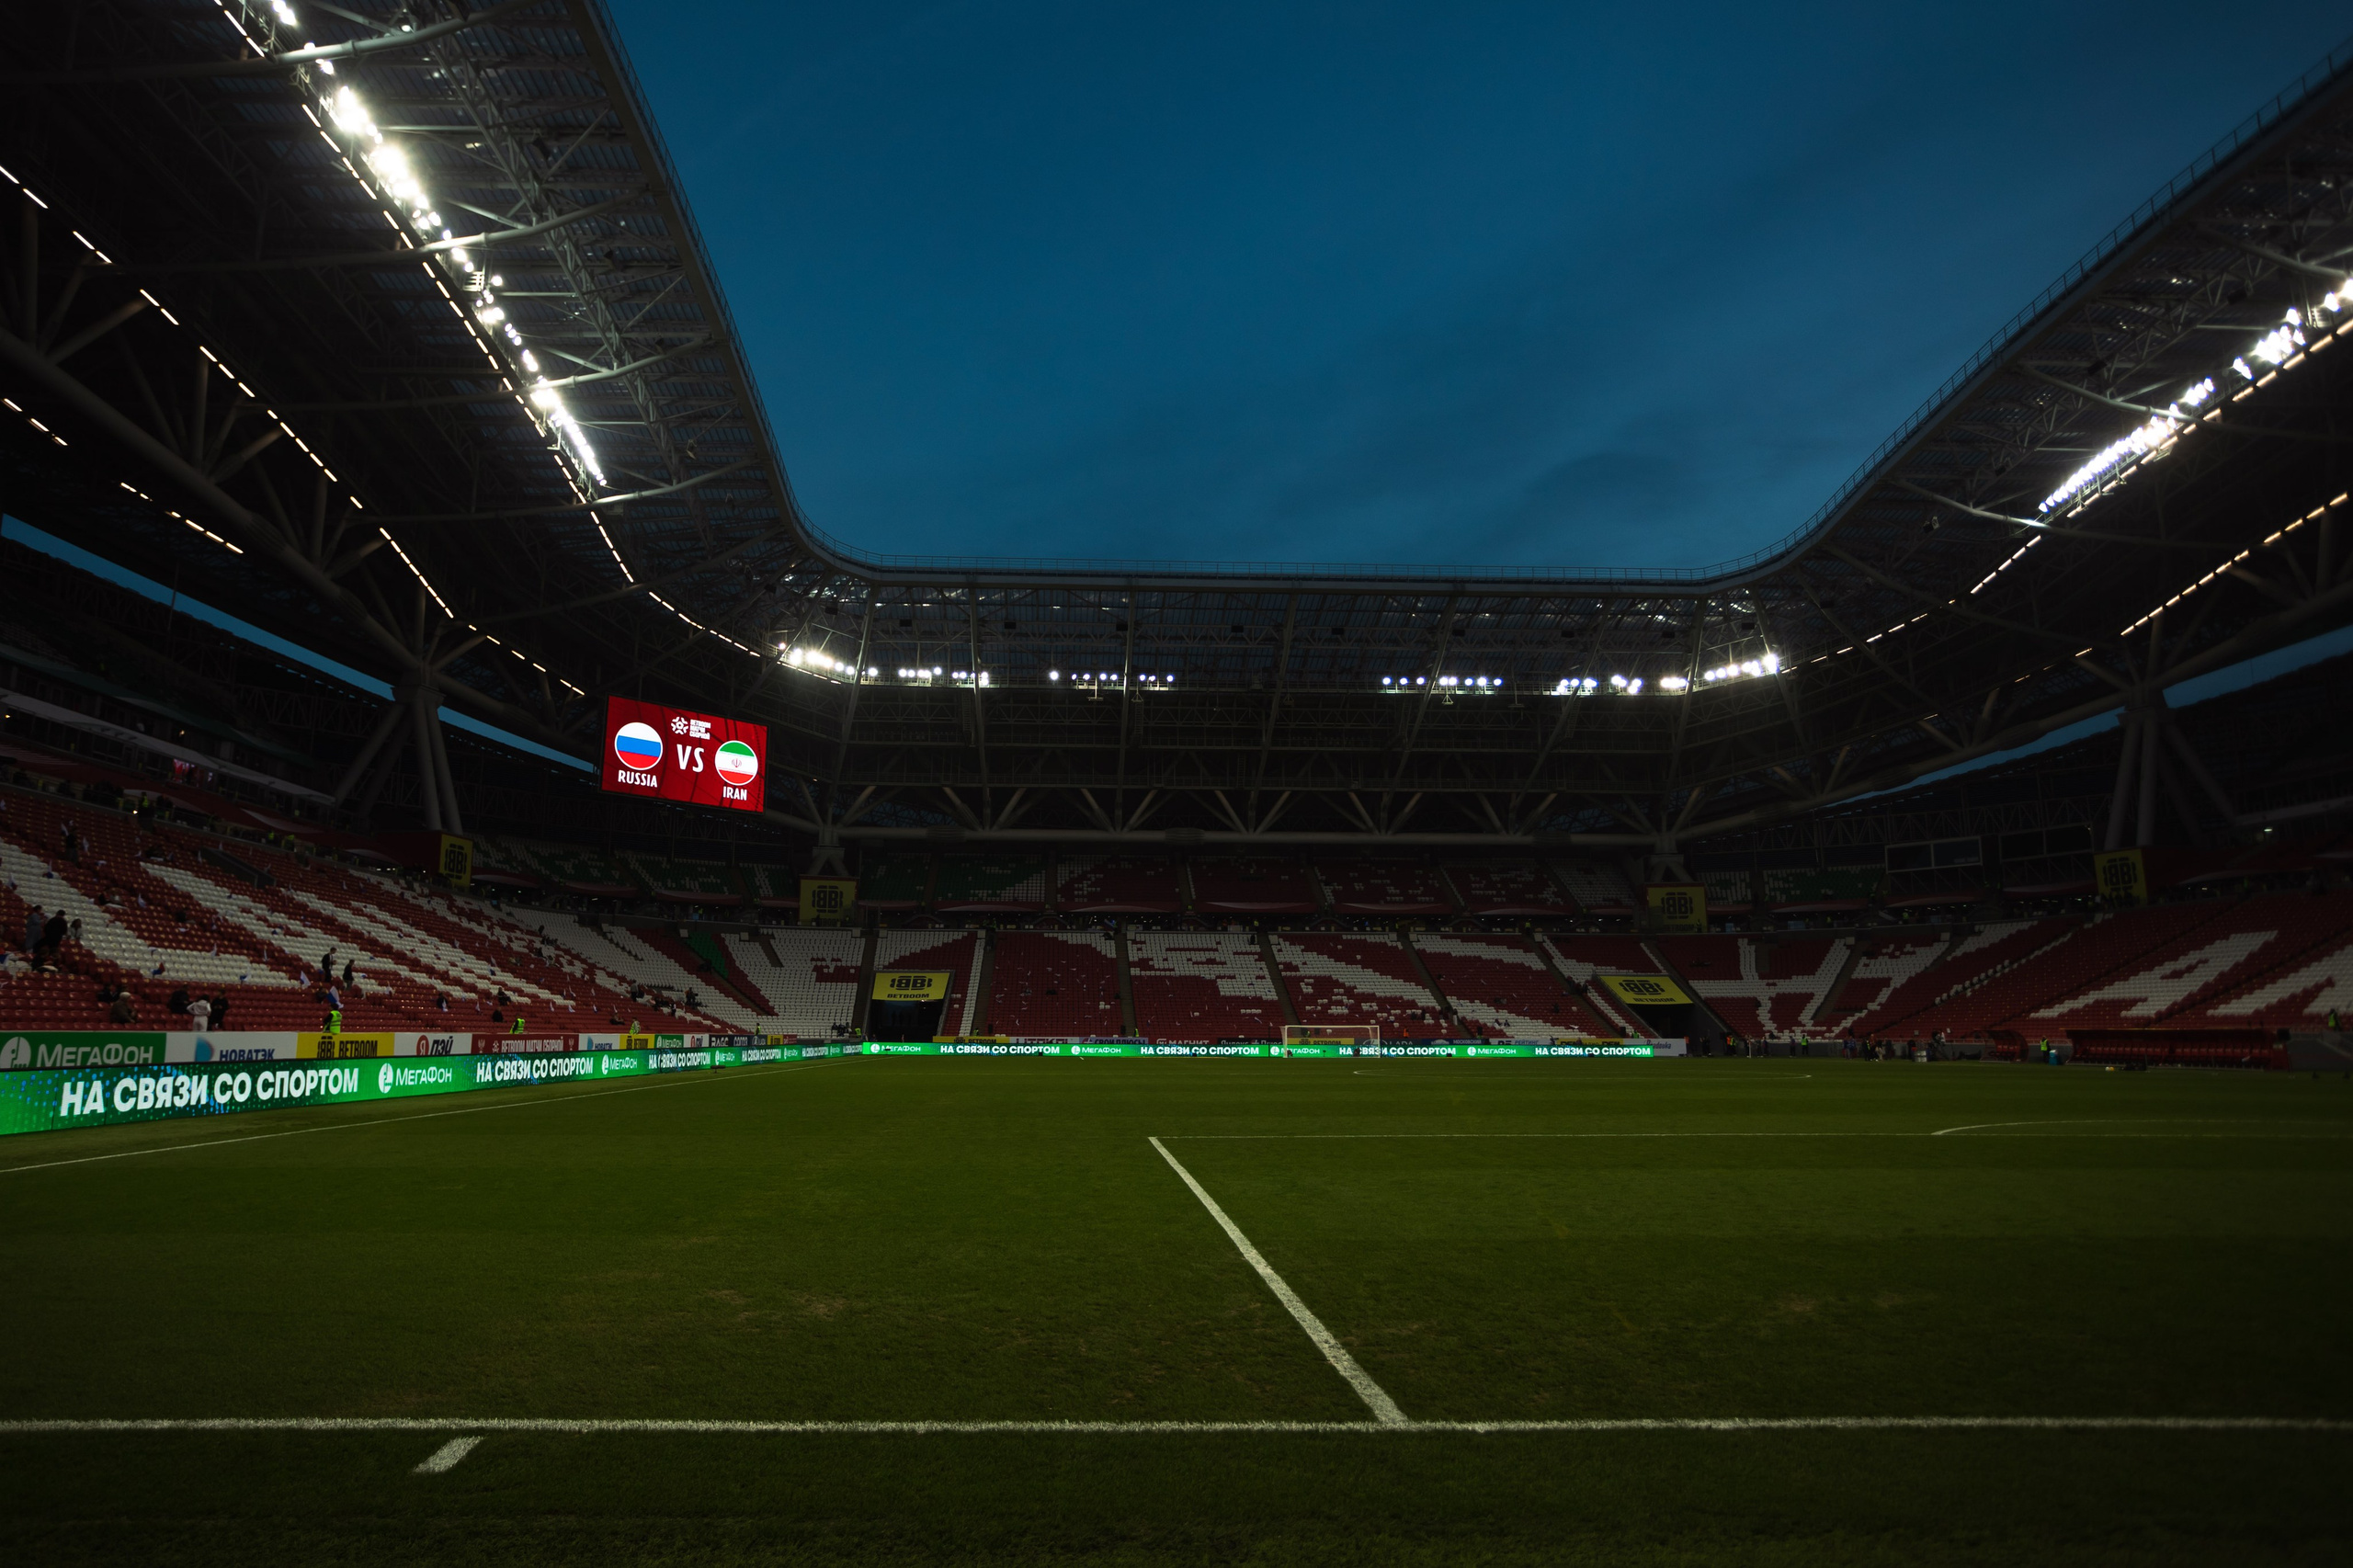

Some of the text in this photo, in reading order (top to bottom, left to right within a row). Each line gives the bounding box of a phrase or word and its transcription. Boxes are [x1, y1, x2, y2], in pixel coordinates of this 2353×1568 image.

[676, 744, 705, 773] VS
[618, 769, 658, 788] RUSSIA
[722, 786, 747, 801] IRAN
[219, 1049, 275, 1062] НОВАТЭК
[338, 1040, 378, 1058] BETBOOM
[940, 1045, 1060, 1054] НА СВЯЗИ СО СПОРТОМ
[1140, 1046, 1259, 1055] НА СВЯЗИ СО СПОРТОМ
[1535, 1047, 1651, 1055] НА СВЯЗИ СО СПОРТОМ
[476, 1057, 594, 1083] НА СВЯЗИ СО СПОРТОМ
[59, 1068, 359, 1117] НА СВЯЗИ СО СПОРТОМ
